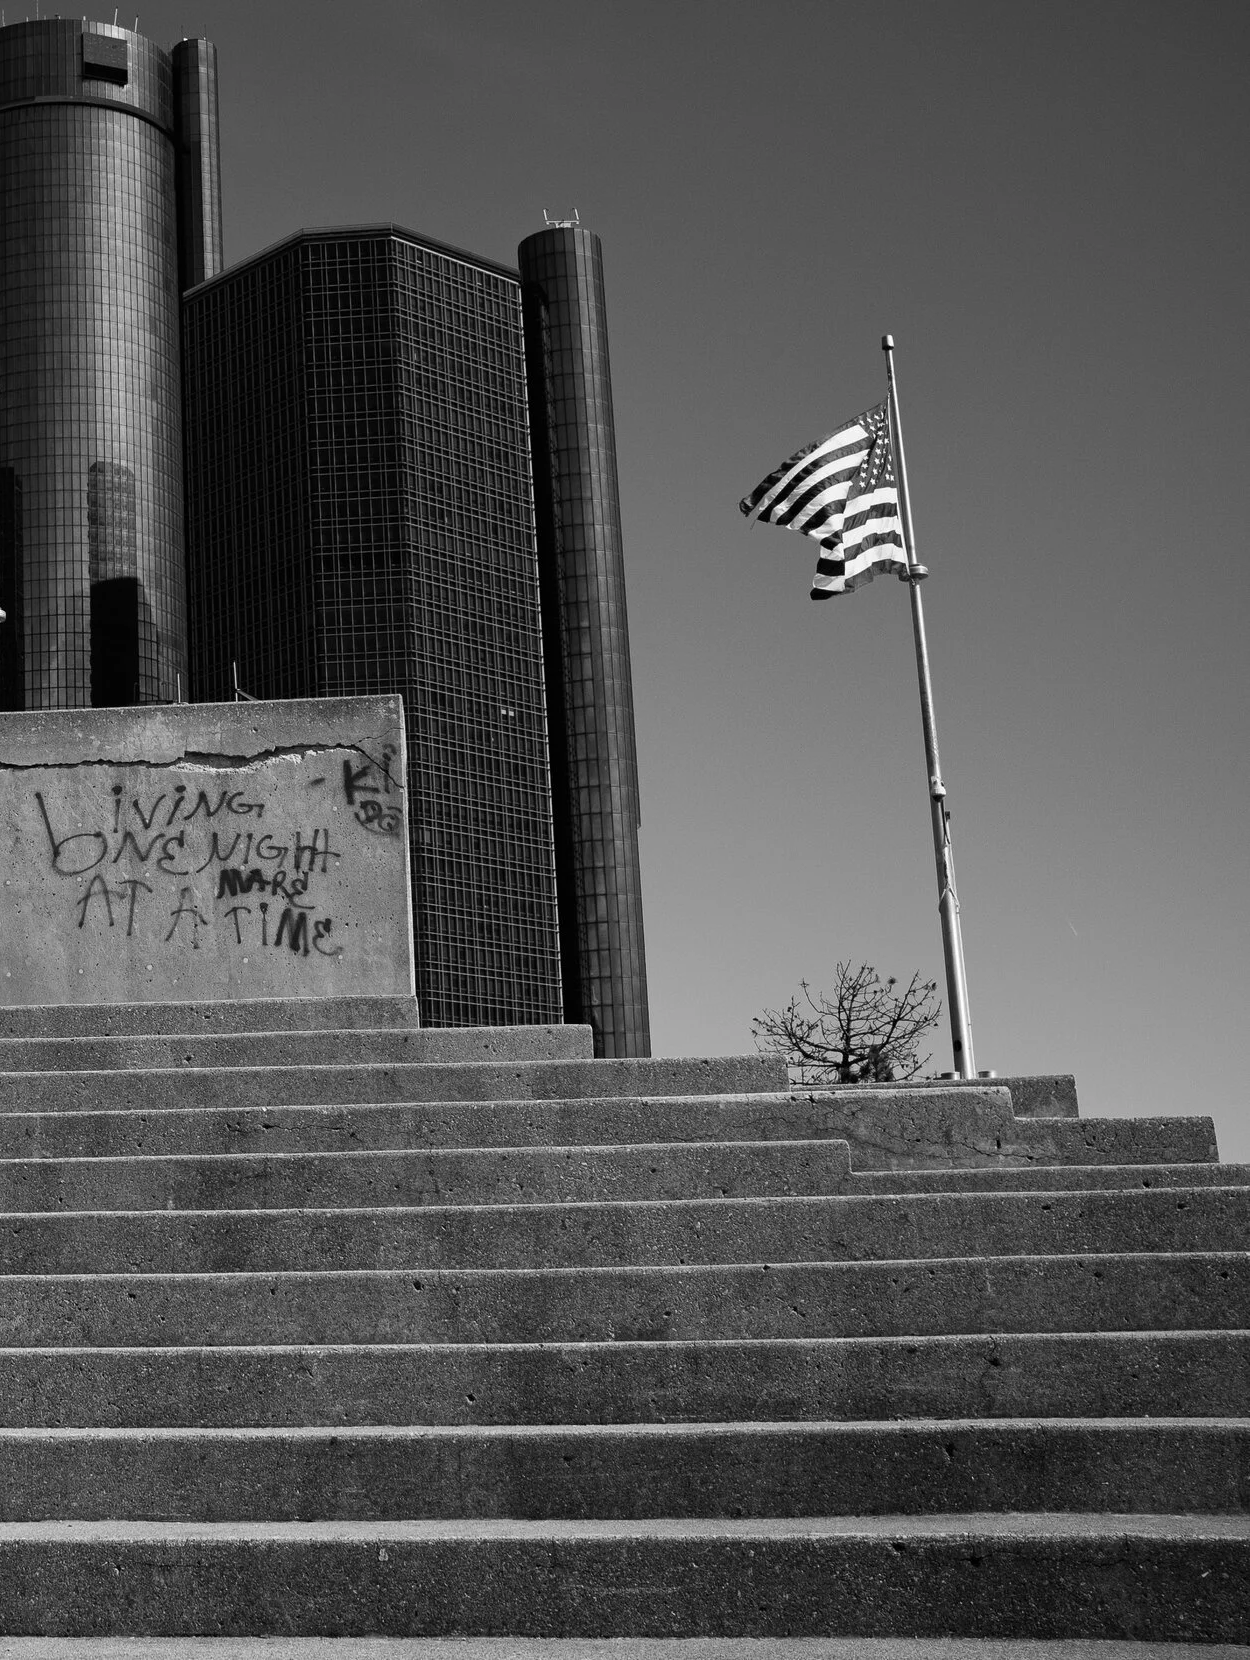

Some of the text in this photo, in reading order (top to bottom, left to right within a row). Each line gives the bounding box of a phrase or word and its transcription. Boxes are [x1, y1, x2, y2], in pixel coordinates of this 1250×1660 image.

[52, 830, 189, 875] ONE
[77, 874, 153, 936] AT
[165, 886, 208, 949] A
